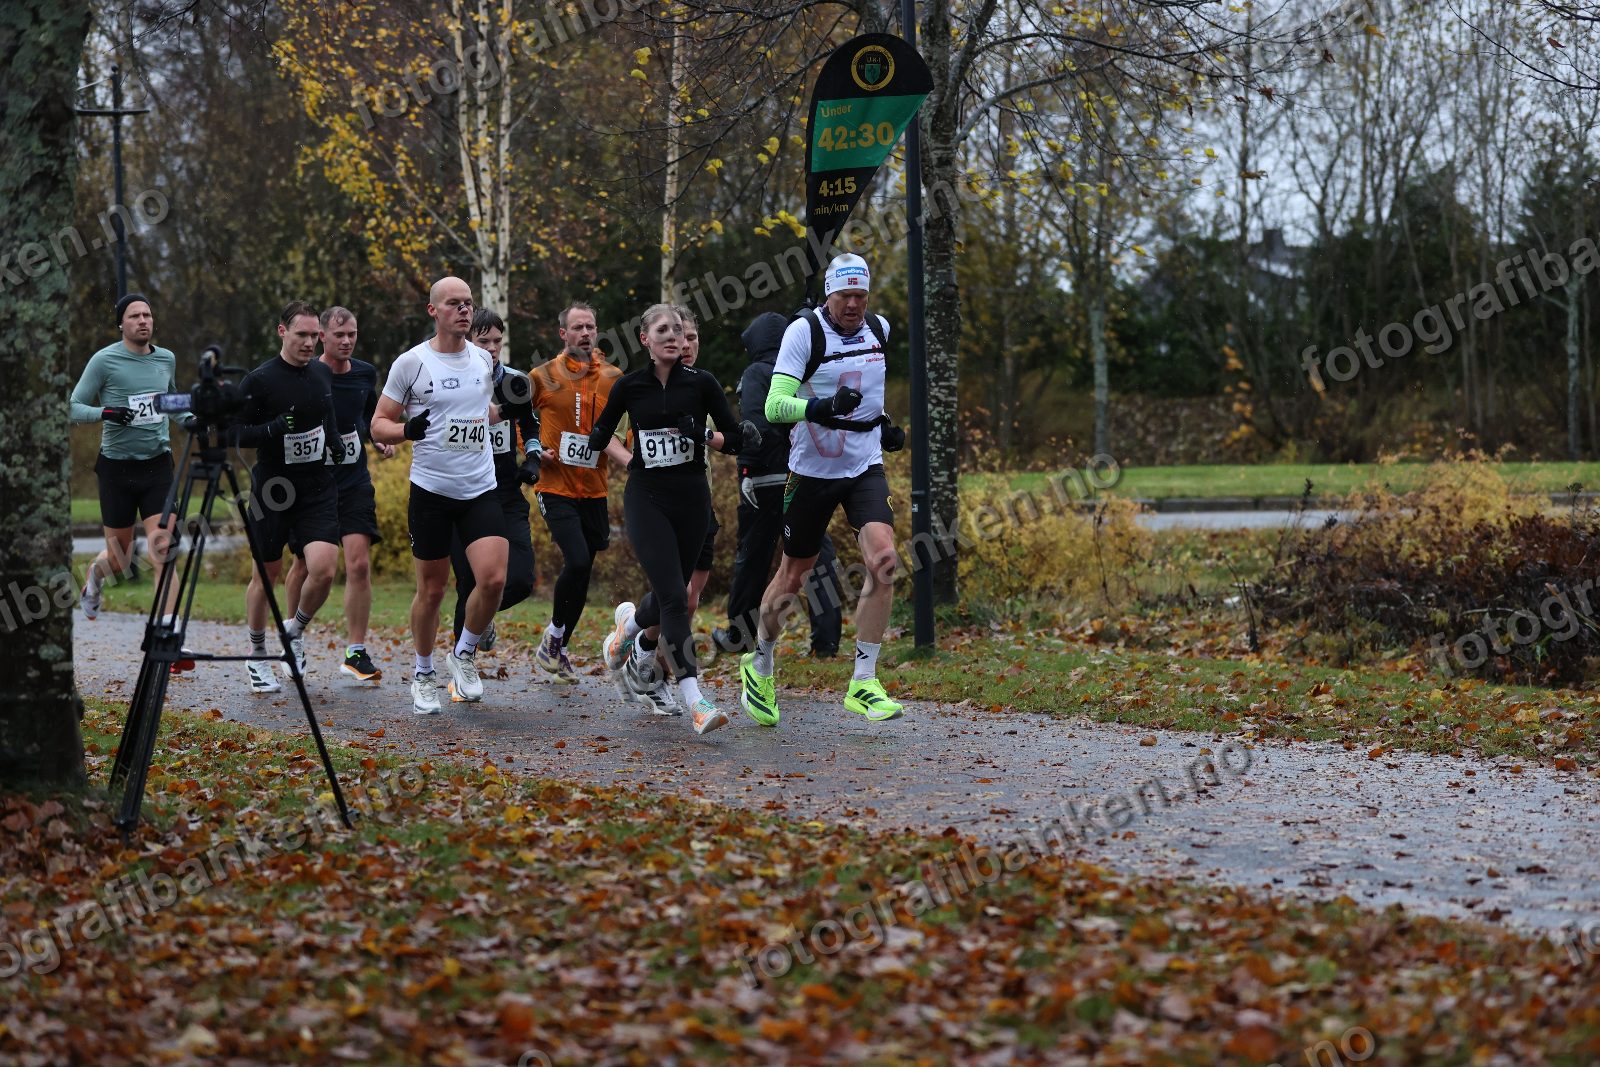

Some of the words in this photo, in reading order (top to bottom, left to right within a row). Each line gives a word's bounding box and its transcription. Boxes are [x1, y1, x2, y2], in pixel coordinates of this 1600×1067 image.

[820, 104, 852, 118] Under
[817, 122, 895, 152] 42:30
[818, 176, 857, 197] 4:15
[813, 203, 849, 215] min/km
[448, 425, 485, 443] 2140
[293, 437, 320, 457] 357
[567, 442, 593, 461] 640
[645, 435, 690, 459] 9118
